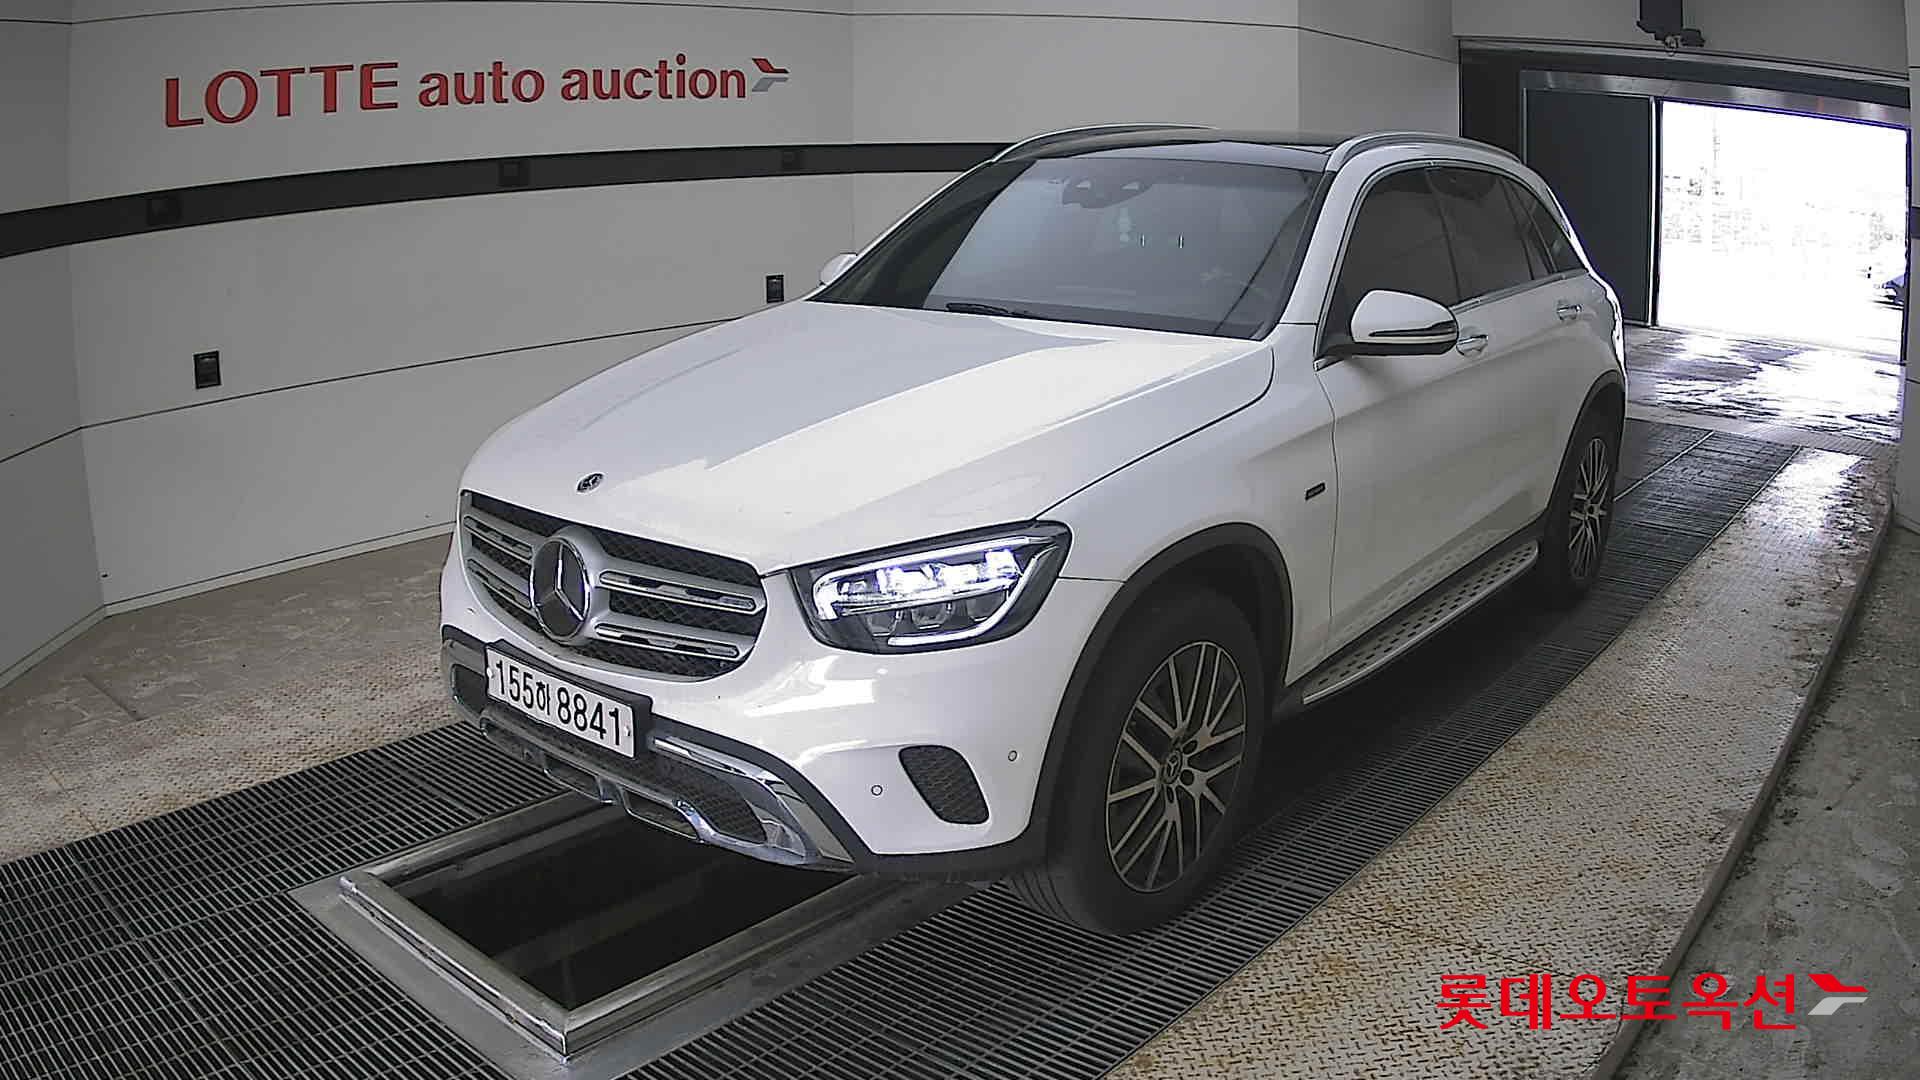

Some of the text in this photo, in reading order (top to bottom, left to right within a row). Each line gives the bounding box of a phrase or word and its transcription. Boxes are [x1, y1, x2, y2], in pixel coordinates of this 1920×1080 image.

[165, 53, 747, 128] LOTTE auto auction
[495, 659, 621, 746] 155하 8841
